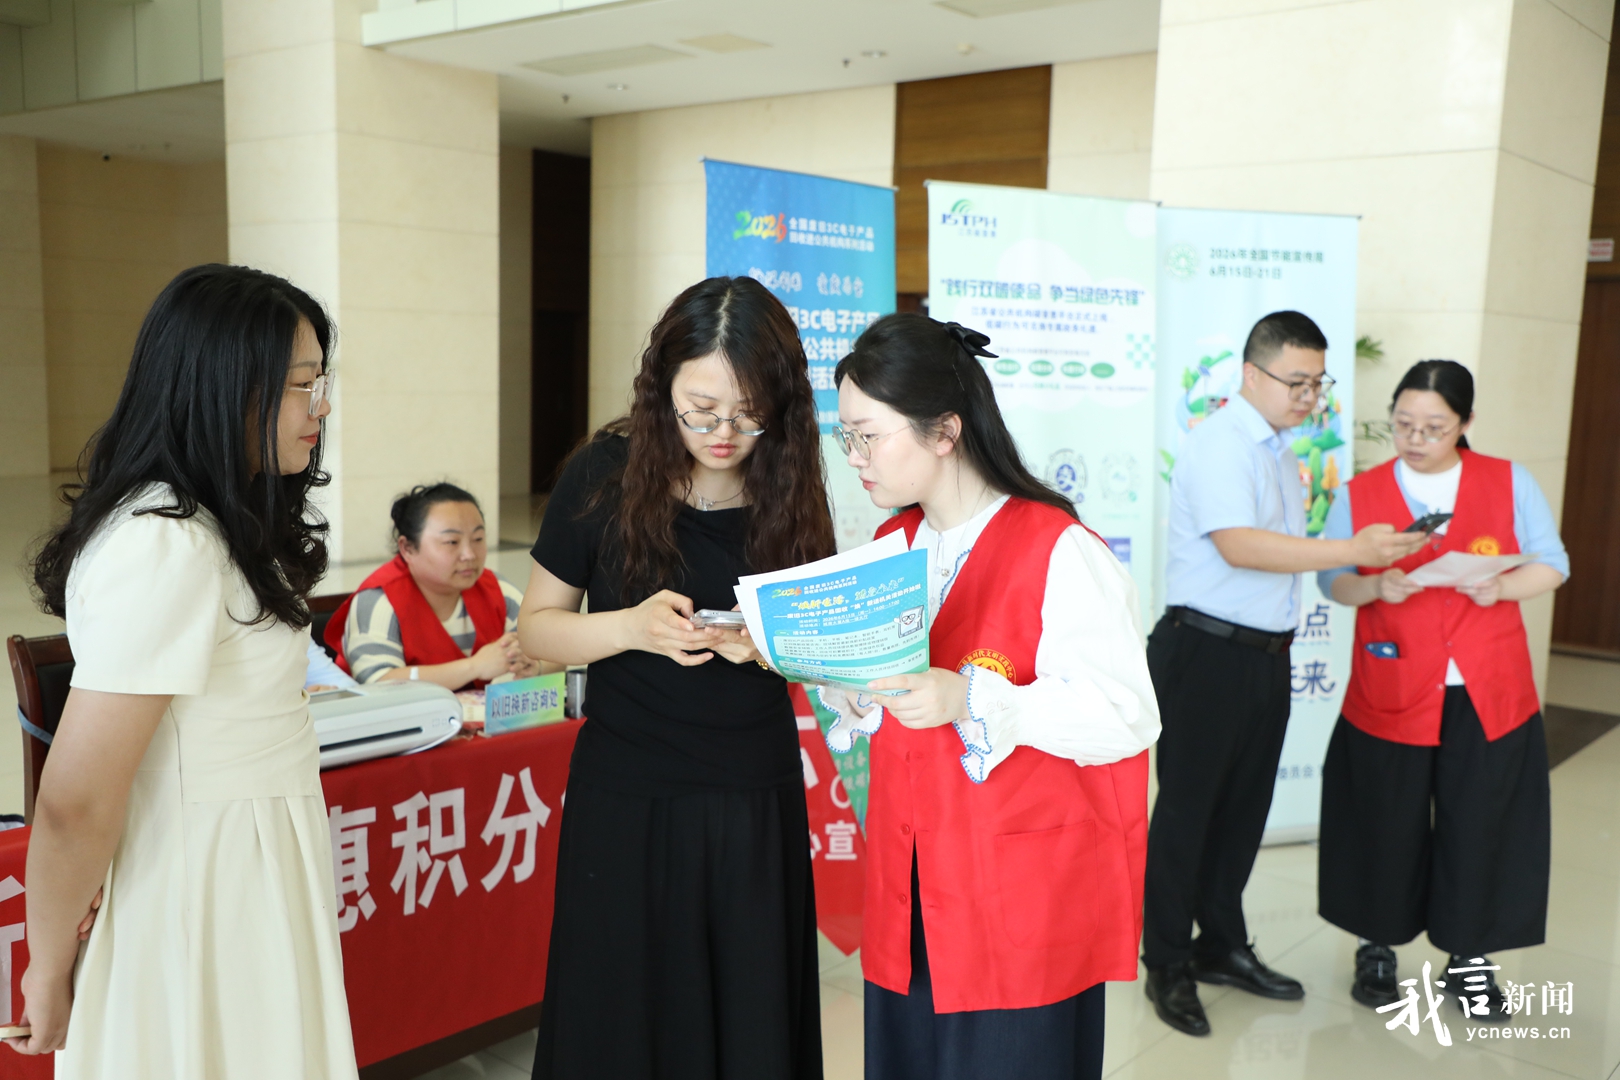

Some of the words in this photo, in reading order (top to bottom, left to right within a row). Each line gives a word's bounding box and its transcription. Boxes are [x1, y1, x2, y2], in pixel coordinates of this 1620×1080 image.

[732, 209, 787, 243] 2026
[1210, 248, 1323, 263] 2026年全国节能宣传周
[803, 336, 856, 360] 公共机
[492, 687, 558, 718] 以旧换新咨询处
[328, 767, 566, 934] 惠积分
